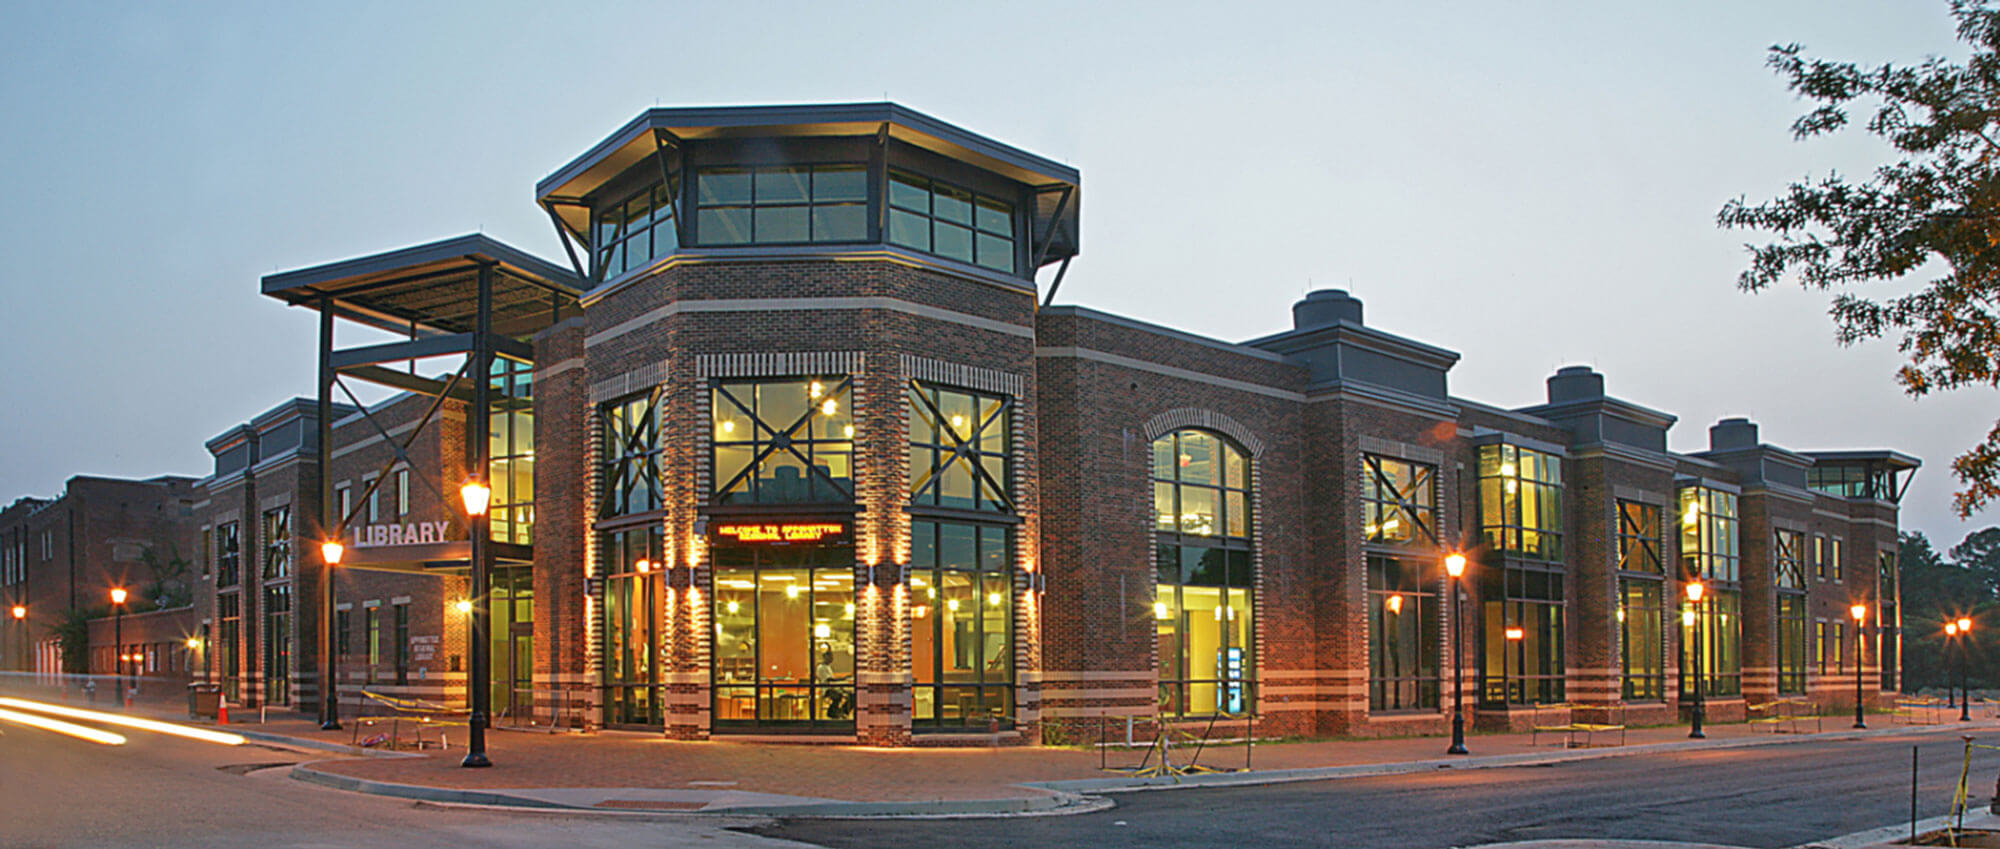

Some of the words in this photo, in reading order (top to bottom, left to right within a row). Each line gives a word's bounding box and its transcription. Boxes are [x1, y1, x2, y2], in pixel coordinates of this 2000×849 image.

[354, 521, 450, 546] LIBRARY
[719, 525, 761, 534] WELCOME
[764, 525, 779, 534] TO
